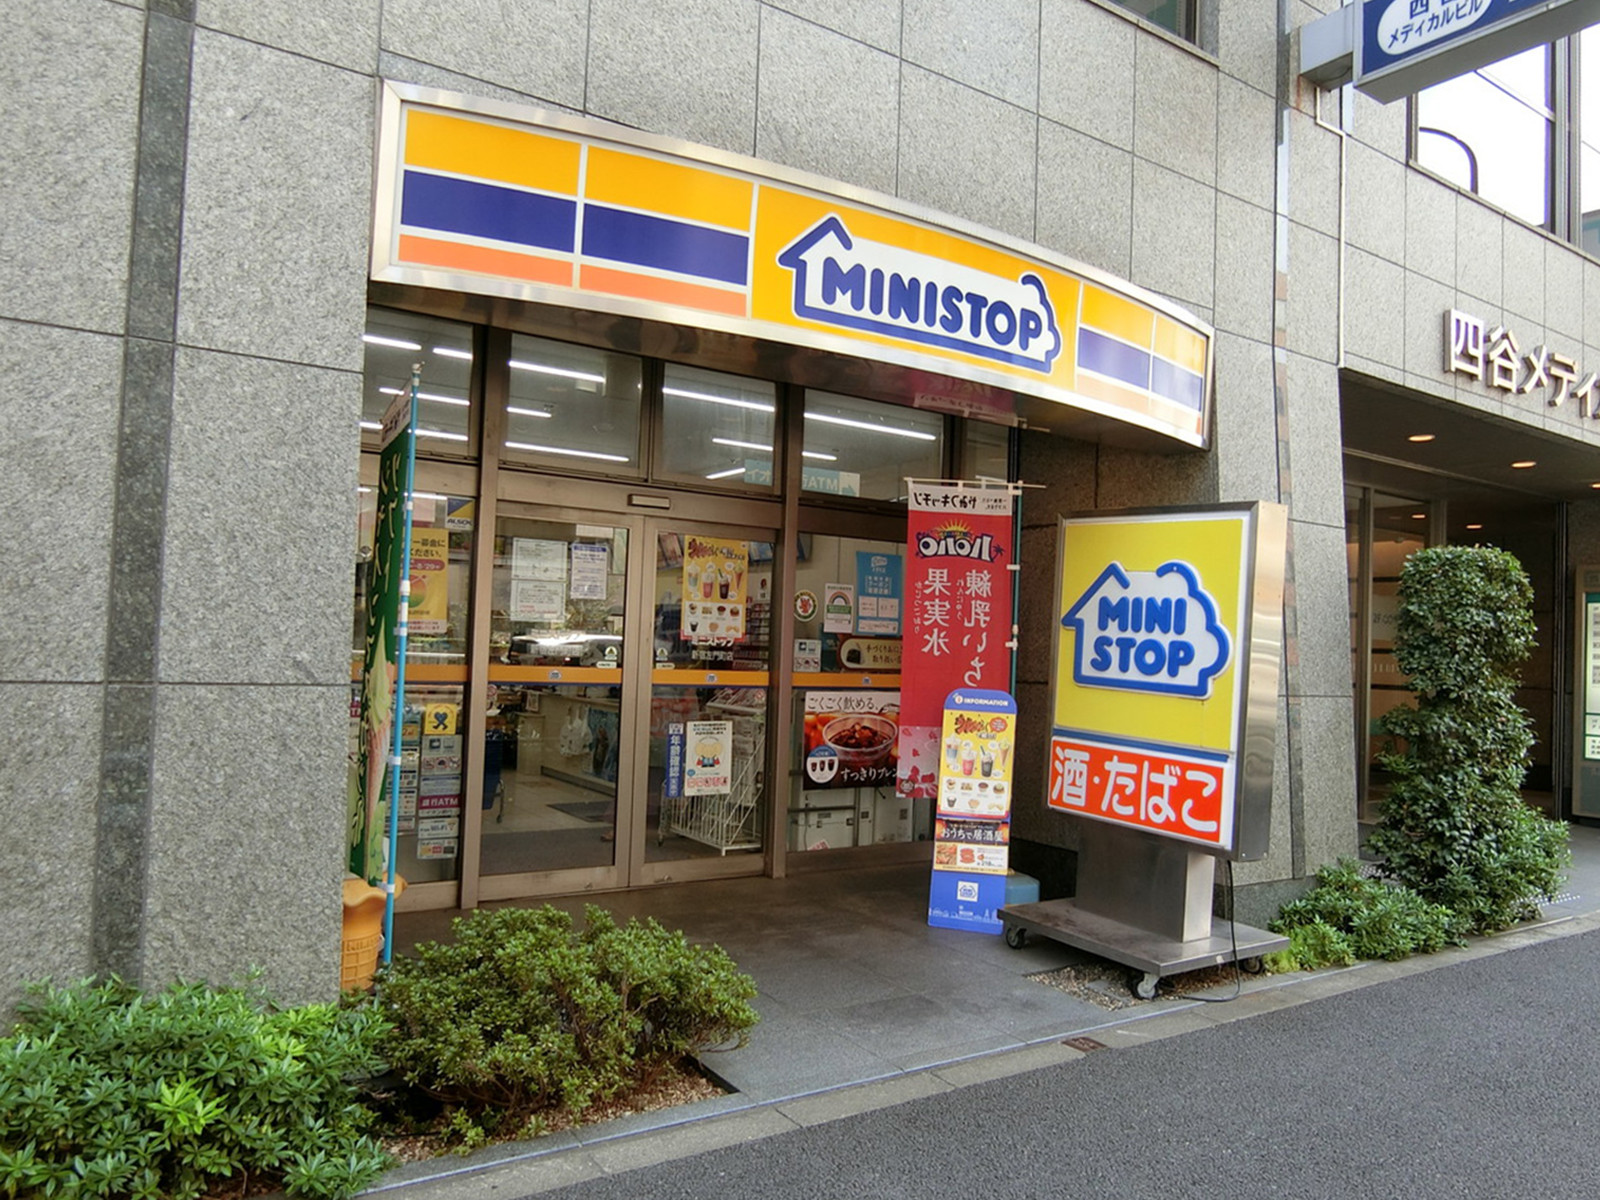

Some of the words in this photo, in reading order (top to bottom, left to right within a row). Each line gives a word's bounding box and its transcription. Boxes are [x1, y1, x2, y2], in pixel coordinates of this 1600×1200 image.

[1387, 0, 1482, 48] メディカルビル
[821, 256, 1043, 351] MINISTOP
[1443, 308, 1600, 419] 四谷メディ
[1097, 595, 1187, 636] MINI
[1090, 635, 1196, 678] STOP
[807, 696, 879, 711] ごくごく飲める、
[963, 698, 1009, 707] INFORMATION
[1051, 745, 1218, 833] 酒・たばこ
